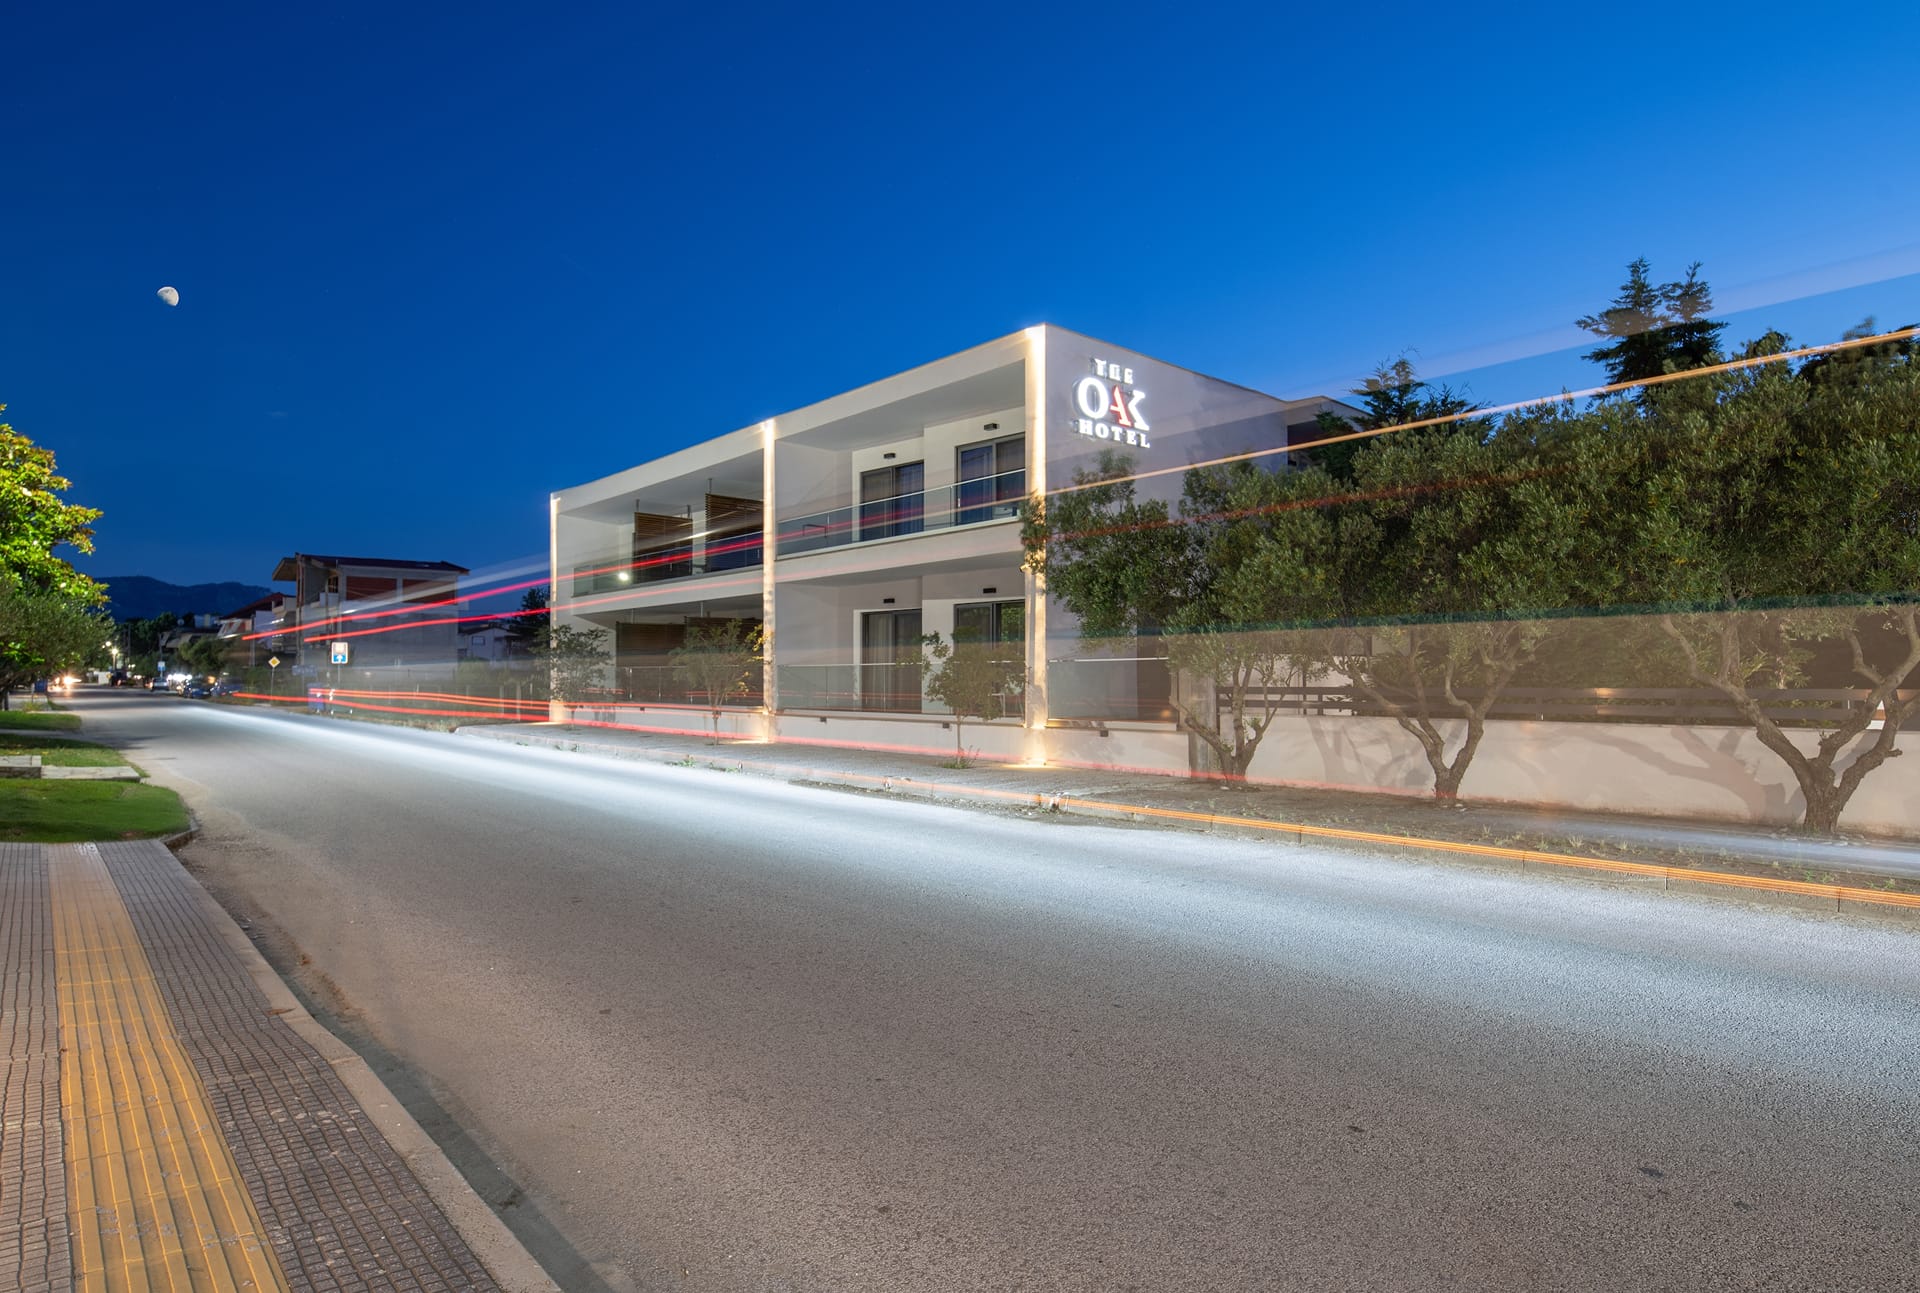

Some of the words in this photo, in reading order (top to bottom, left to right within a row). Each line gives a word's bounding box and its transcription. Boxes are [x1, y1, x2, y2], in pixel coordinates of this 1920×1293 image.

[1094, 358, 1133, 384] THE
[1078, 377, 1150, 431] OAK
[1078, 418, 1151, 448] HOTEL
